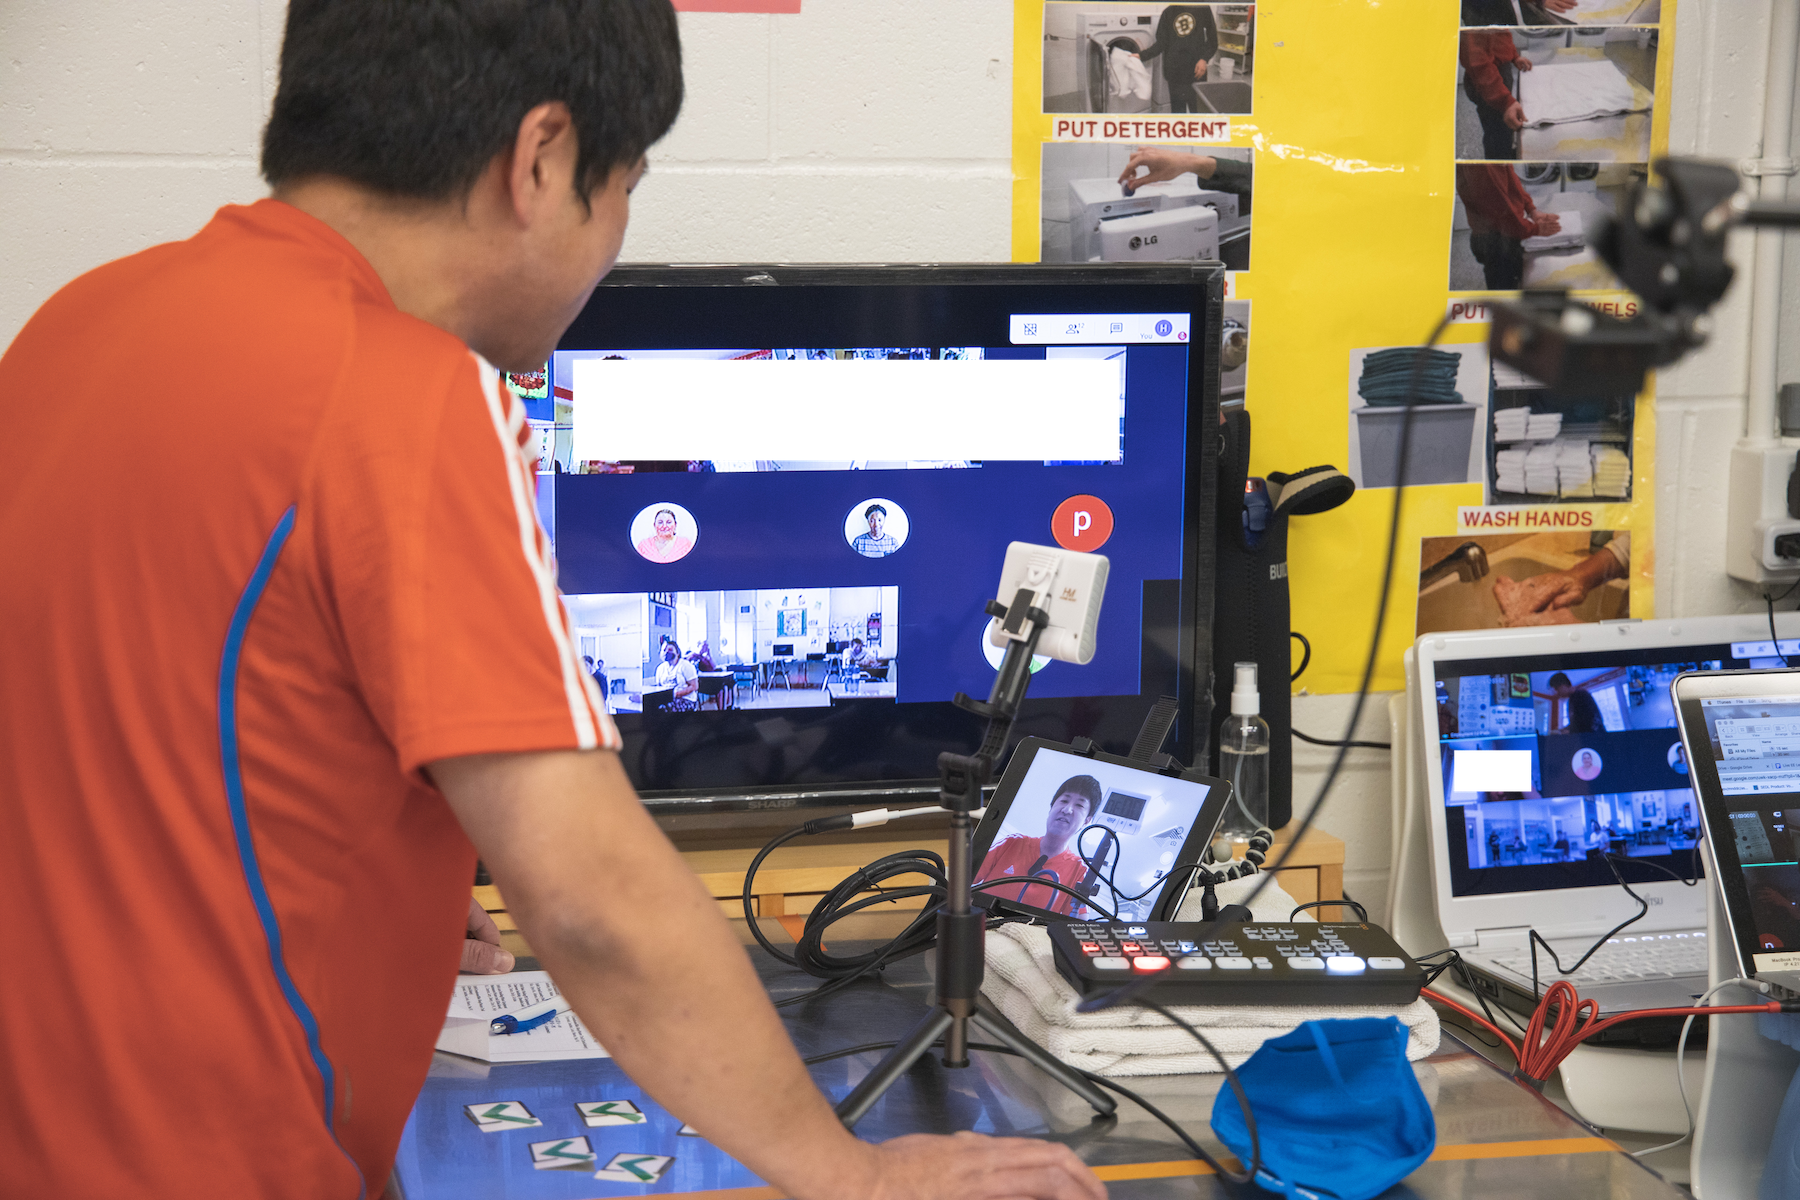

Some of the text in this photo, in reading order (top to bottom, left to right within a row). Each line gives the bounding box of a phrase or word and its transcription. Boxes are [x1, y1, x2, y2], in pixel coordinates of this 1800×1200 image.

[1058, 121, 1227, 139] PUT DETERGENT
[1144, 235, 1158, 246] LG
[1451, 302, 1638, 320] PUT WELS
[1140, 332, 1153, 340] You
[1463, 510, 1593, 527] WASH HANDS
[748, 799, 797, 809] SHARP
